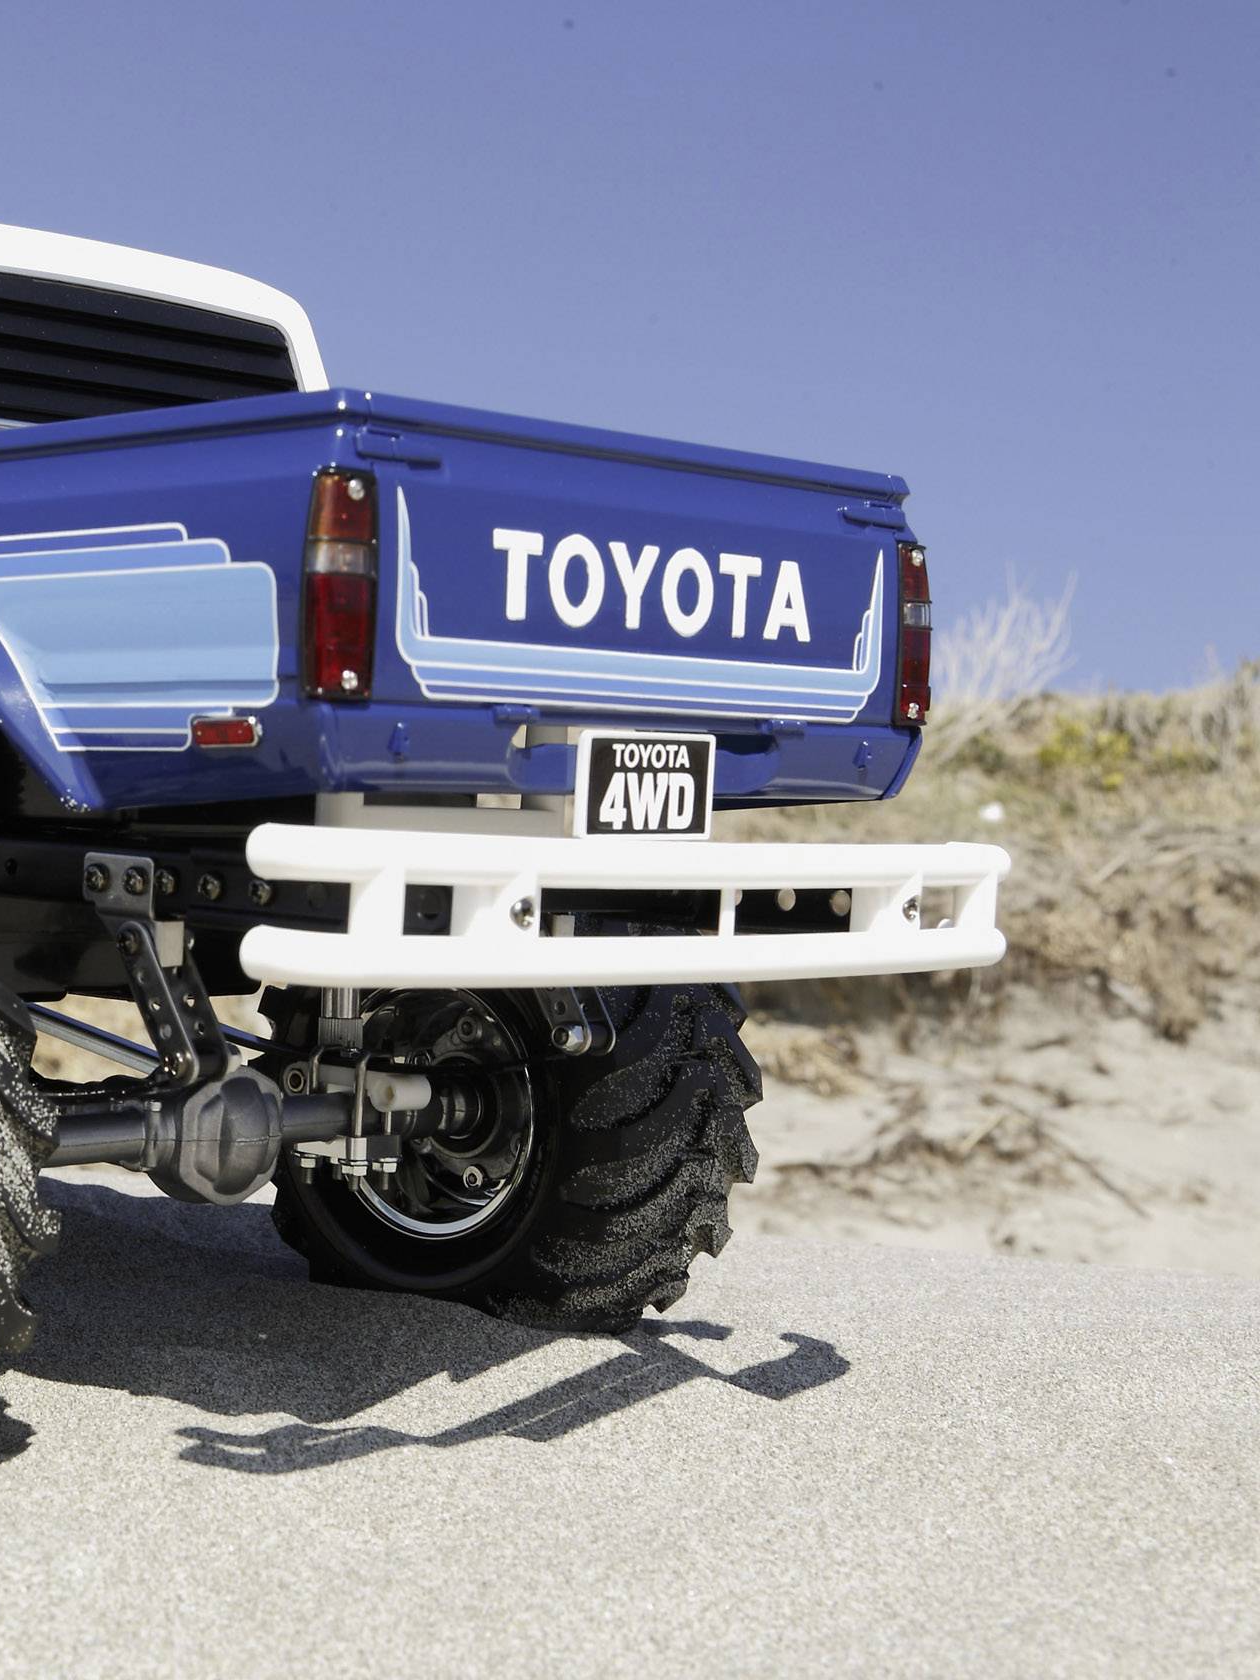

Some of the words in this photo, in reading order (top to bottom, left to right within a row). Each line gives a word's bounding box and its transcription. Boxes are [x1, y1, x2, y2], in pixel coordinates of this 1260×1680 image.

[492, 528, 811, 642] TOYOTA
[612, 743, 690, 769] TOYOTA
[599, 772, 695, 830] 4WD
